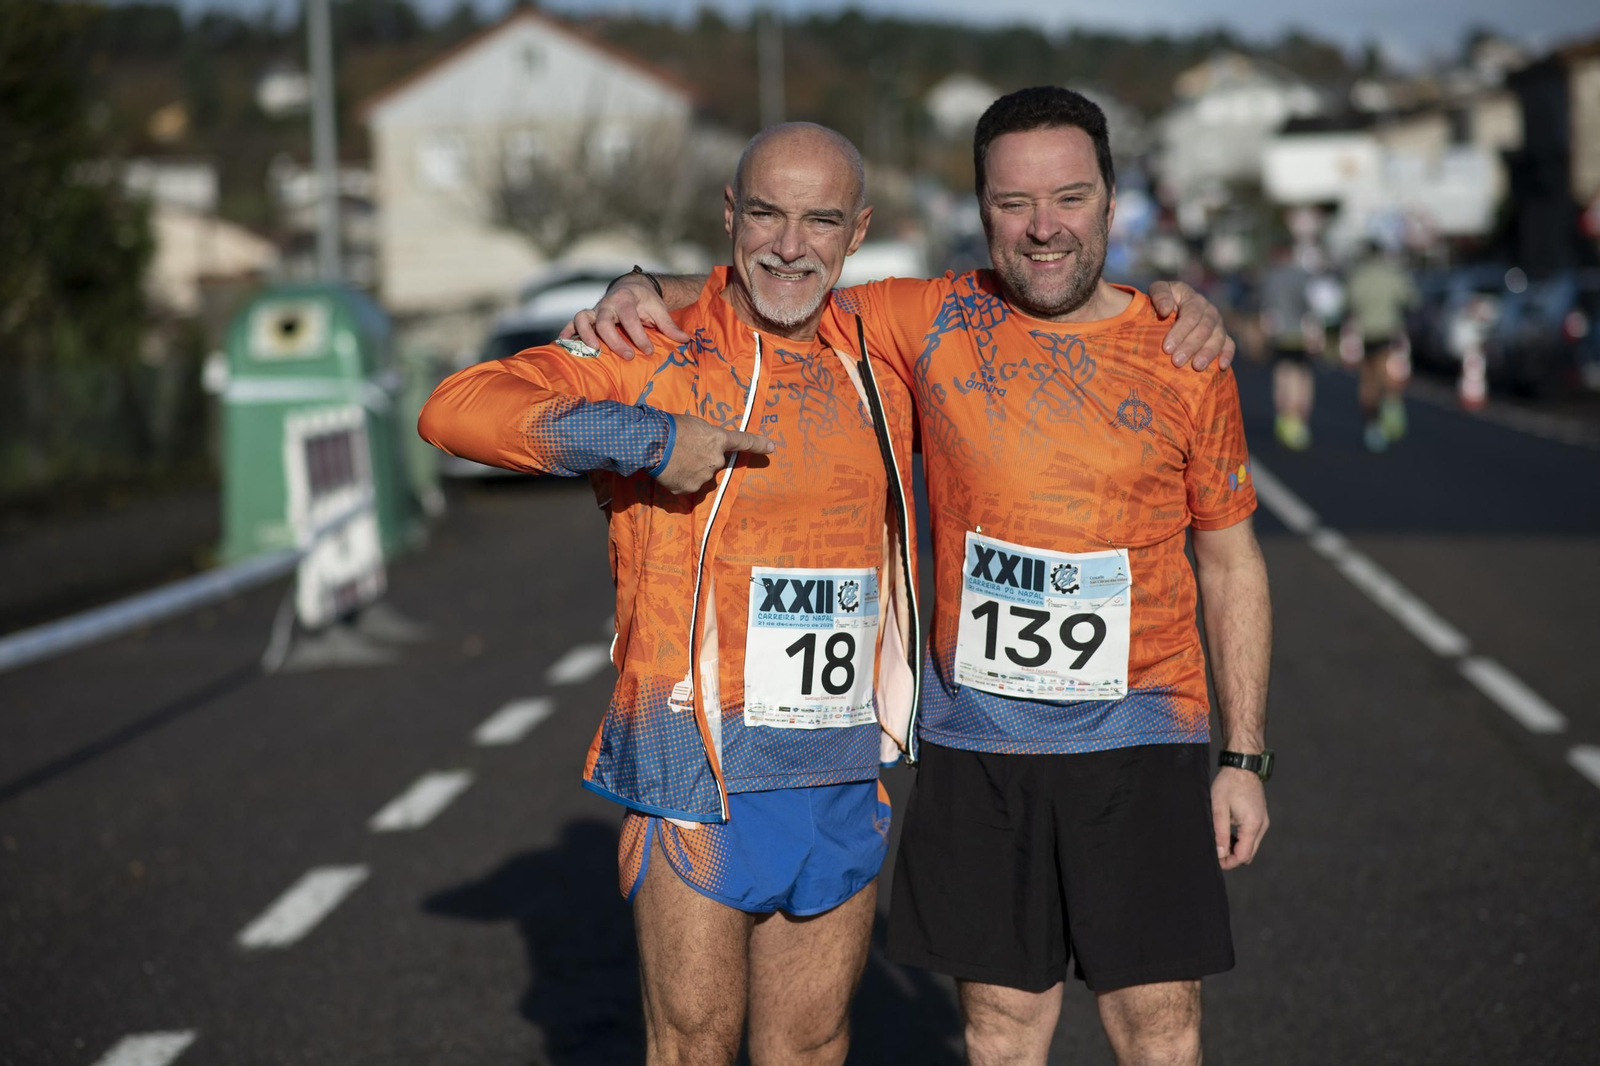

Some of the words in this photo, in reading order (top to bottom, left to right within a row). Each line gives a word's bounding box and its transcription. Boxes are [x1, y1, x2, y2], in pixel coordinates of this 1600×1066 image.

[965, 379, 1007, 397] amura
[970, 543, 1046, 592] XXII
[759, 578, 833, 614] XXII
[968, 577, 1001, 592] CARREIRA
[1004, 587, 1014, 595] DO
[1017, 590, 1044, 600] NADAL
[984, 588, 1015, 600] decembro
[758, 613, 796, 621] CARREIRA
[800, 614, 809, 622] DO
[812, 614, 833, 622] NADAL
[971, 600, 1107, 670] 139
[785, 632, 856, 695] 18
